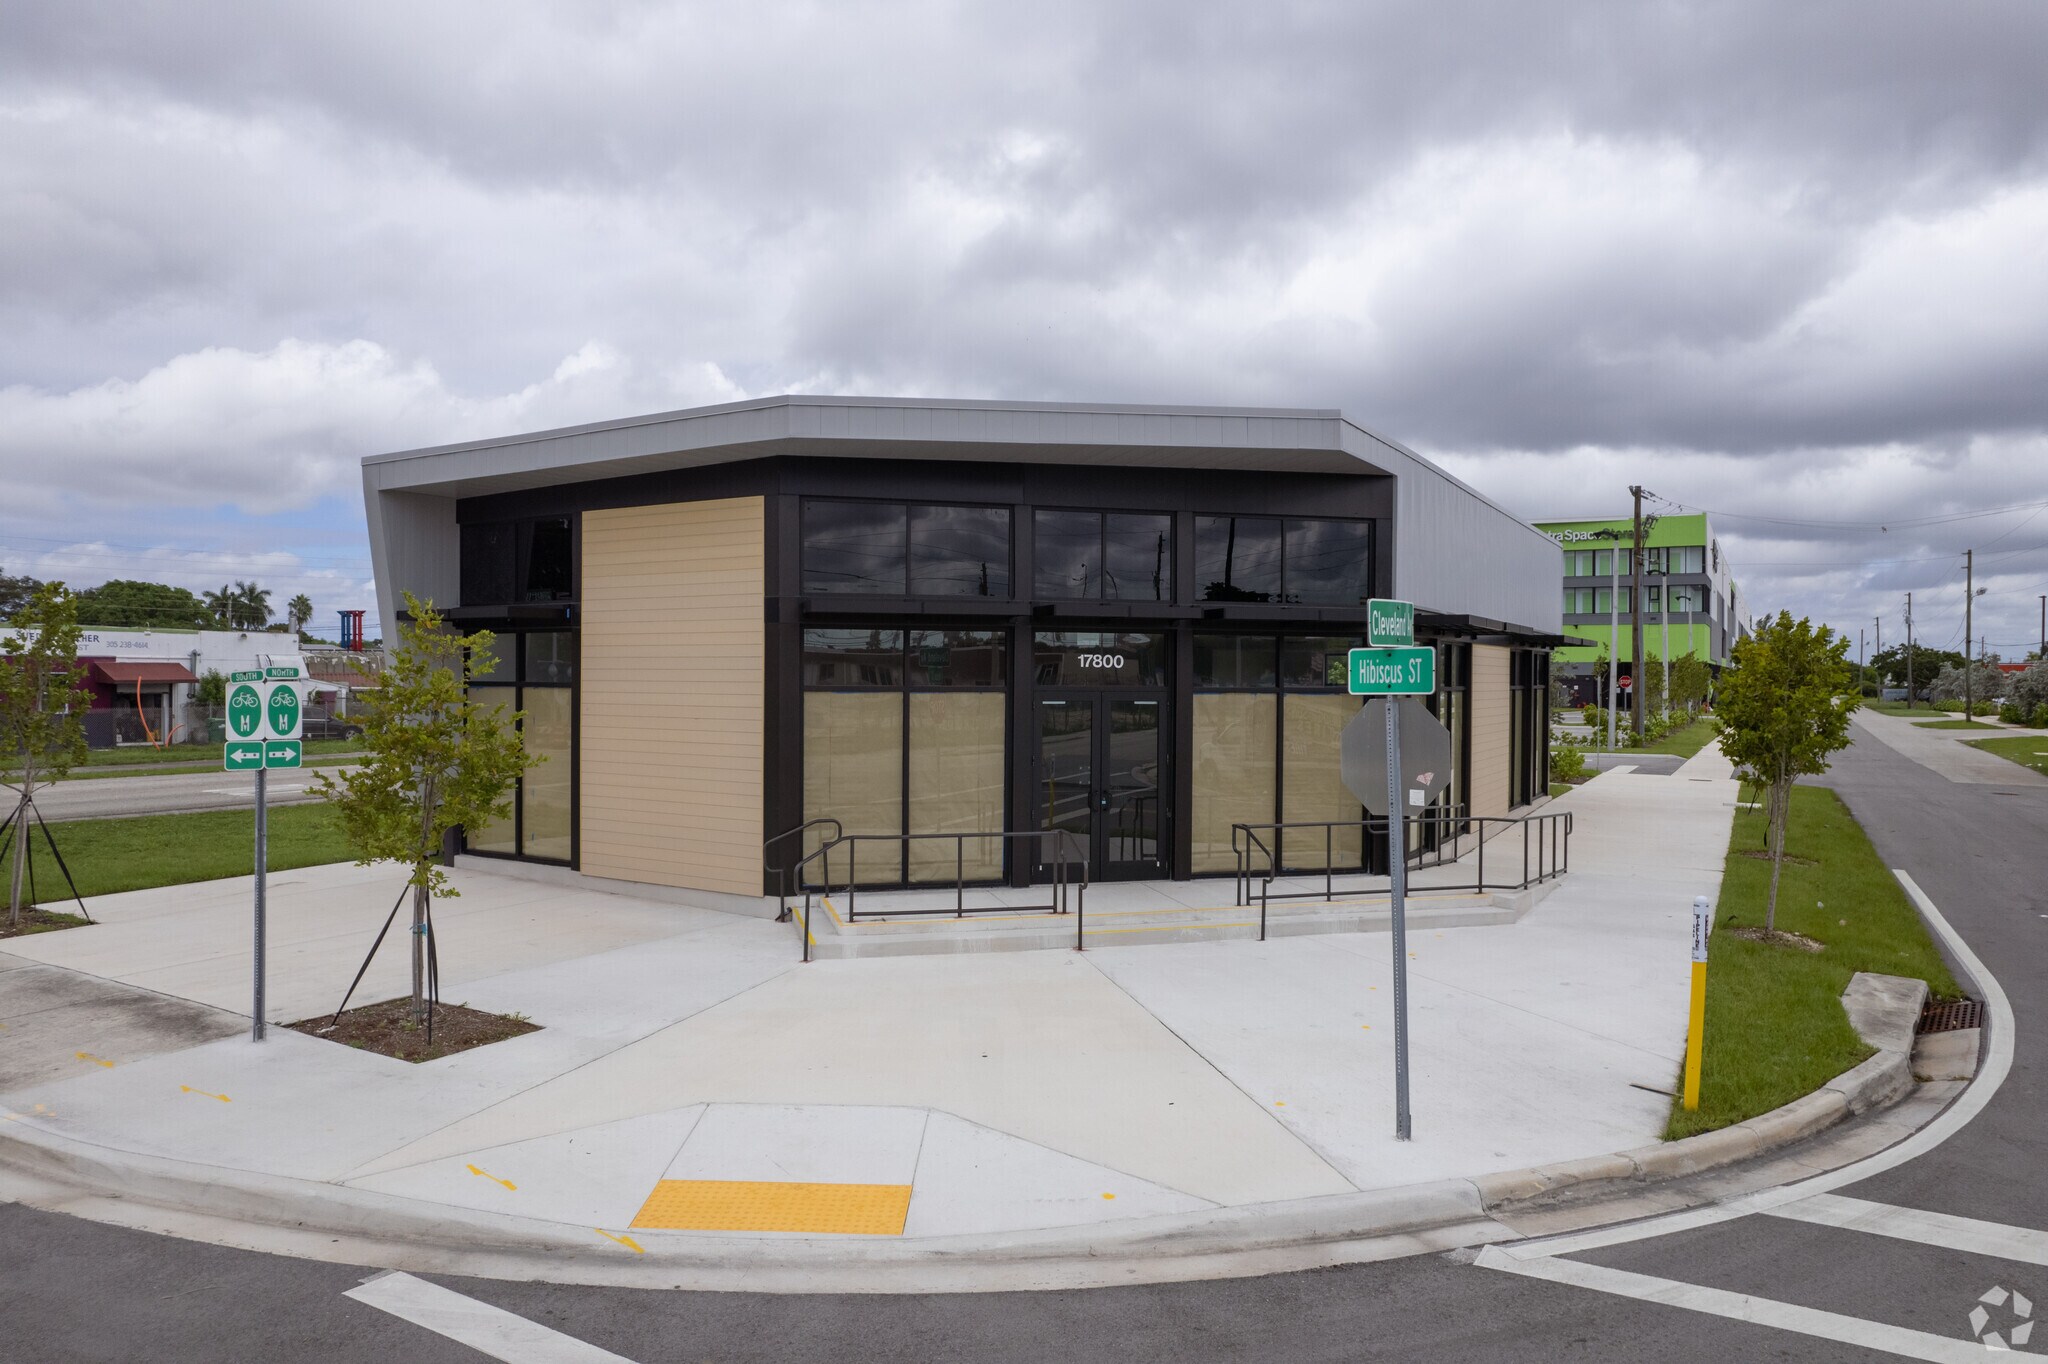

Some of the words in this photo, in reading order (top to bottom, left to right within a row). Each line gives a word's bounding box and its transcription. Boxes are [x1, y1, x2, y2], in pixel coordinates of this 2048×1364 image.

[1372, 610, 1406, 637] Cleveland
[1077, 654, 1124, 669] 17800
[235, 672, 258, 681] SOUTH
[271, 668, 294, 677] NORTH
[1359, 659, 1403, 684] Hibiscus
[1408, 658, 1422, 684] ST
